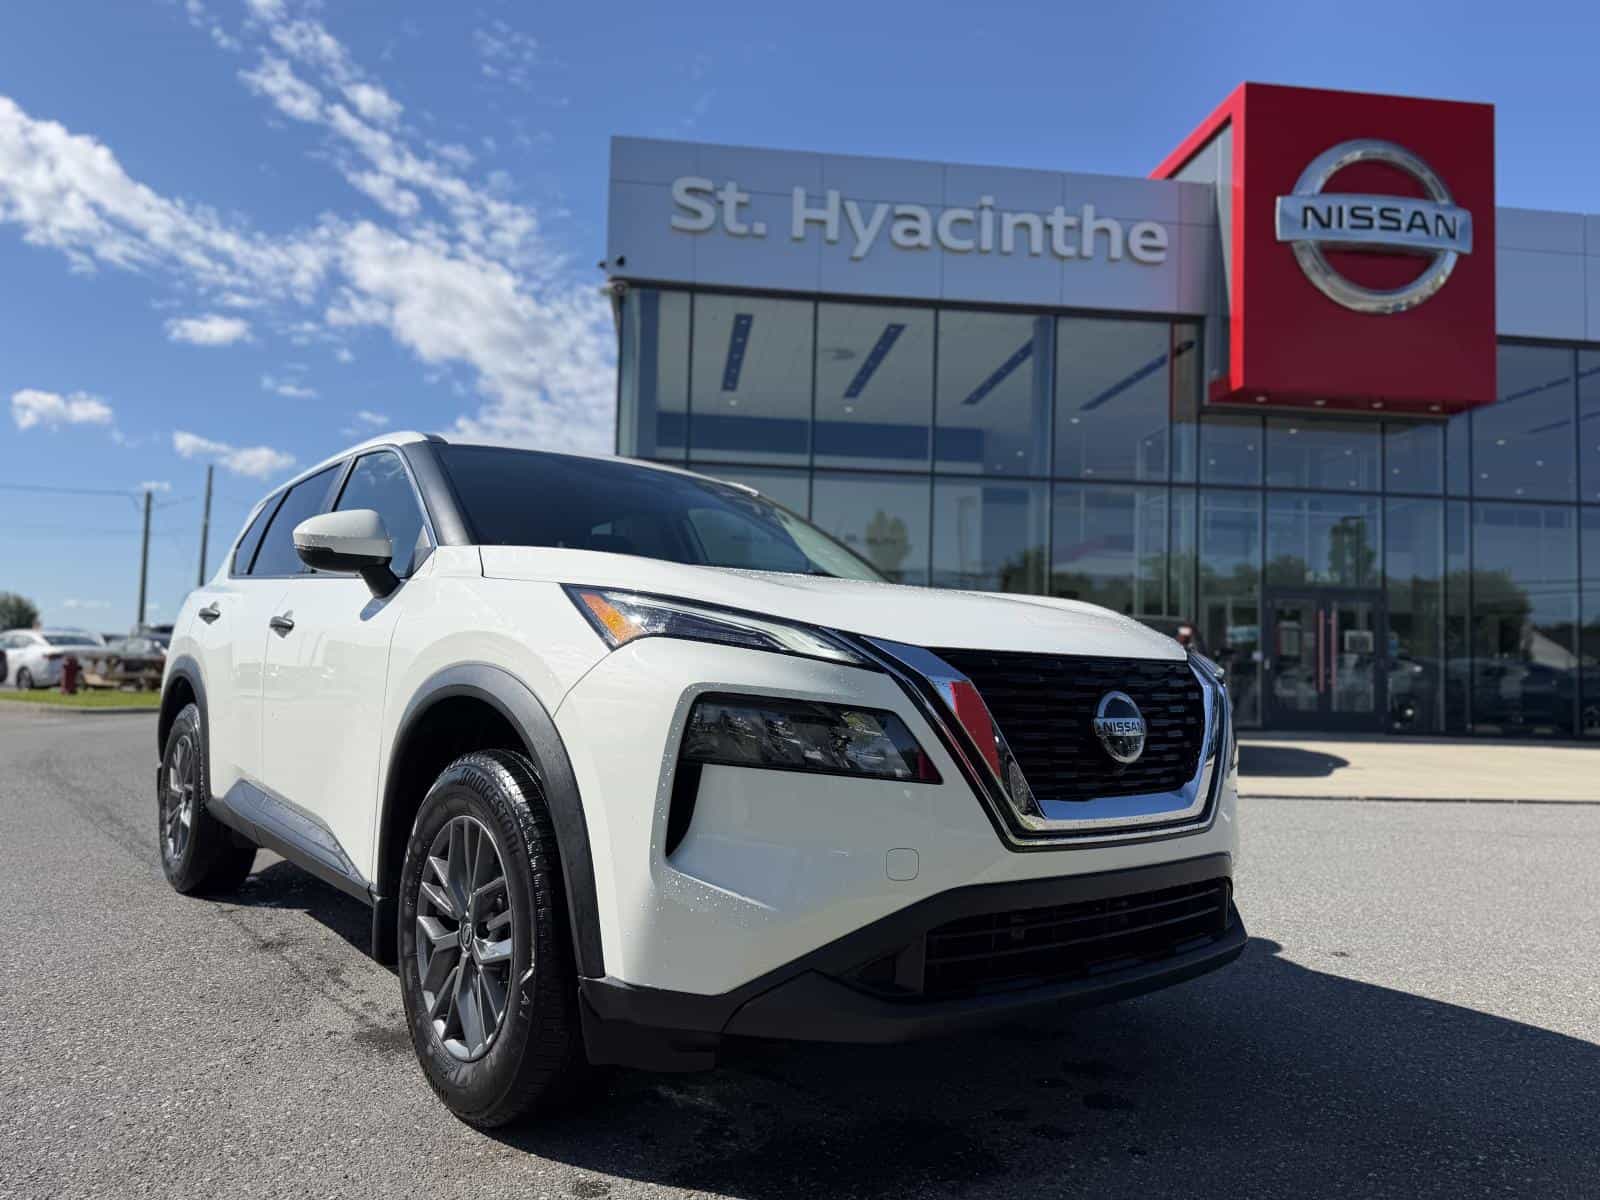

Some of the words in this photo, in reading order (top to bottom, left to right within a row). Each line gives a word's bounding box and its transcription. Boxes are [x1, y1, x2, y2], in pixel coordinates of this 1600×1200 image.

[671, 176, 767, 238] St.
[791, 186, 1169, 264] Hyacinthe
[1302, 205, 1457, 241] NISSAN
[1103, 720, 1143, 733] NISSAN
